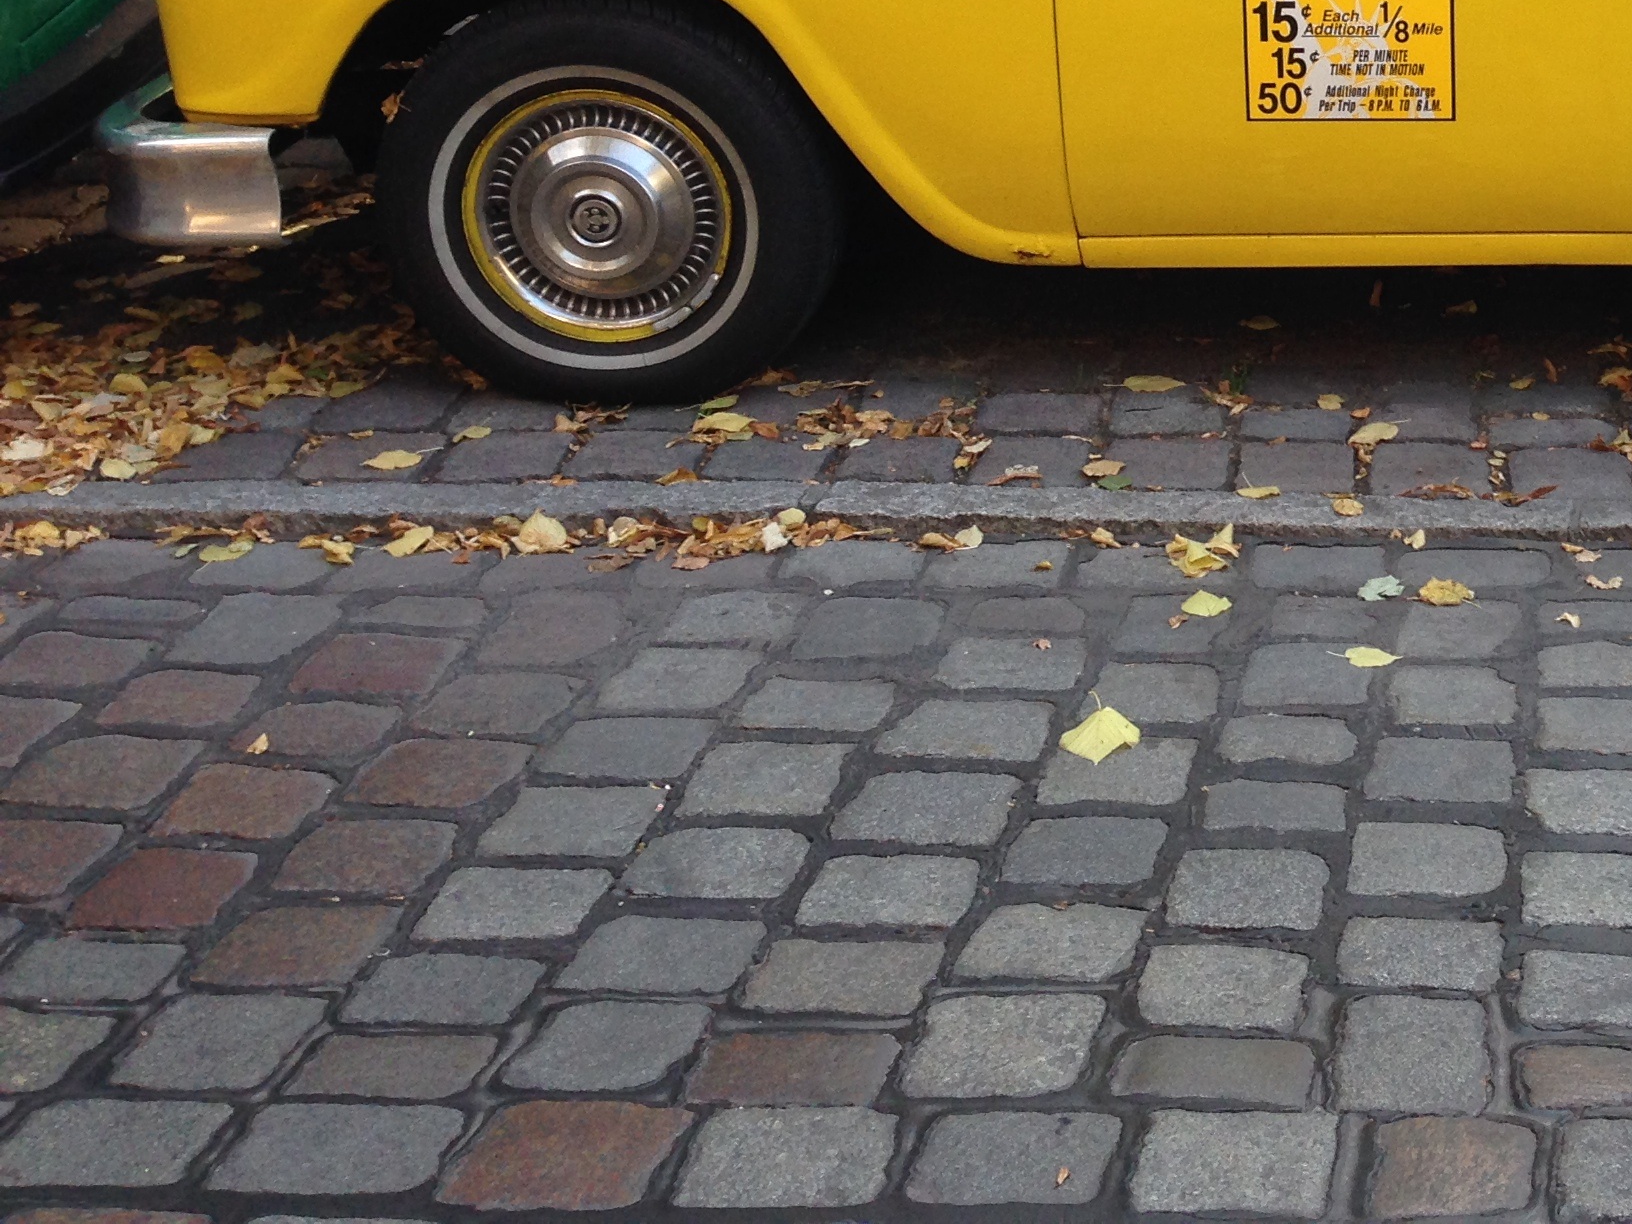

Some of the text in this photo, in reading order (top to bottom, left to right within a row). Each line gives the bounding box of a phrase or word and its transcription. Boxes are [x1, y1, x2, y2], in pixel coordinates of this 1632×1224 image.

[1322, 8, 1360, 23] Each
[1303, 23, 1379, 37] Additional
[1411, 22, 1444, 36] Mile
[1352, 49, 1409, 63] PER MINUTE
[1330, 63, 1425, 76] TIME NOT IN MOTION
[1325, 84, 1436, 99] Additional Night Charge
[1318, 99, 1336, 112] Per
[1337, 99, 1356, 114] Trip
[1368, 99, 1375, 112] 8
[1399, 99, 1410, 112] TO
